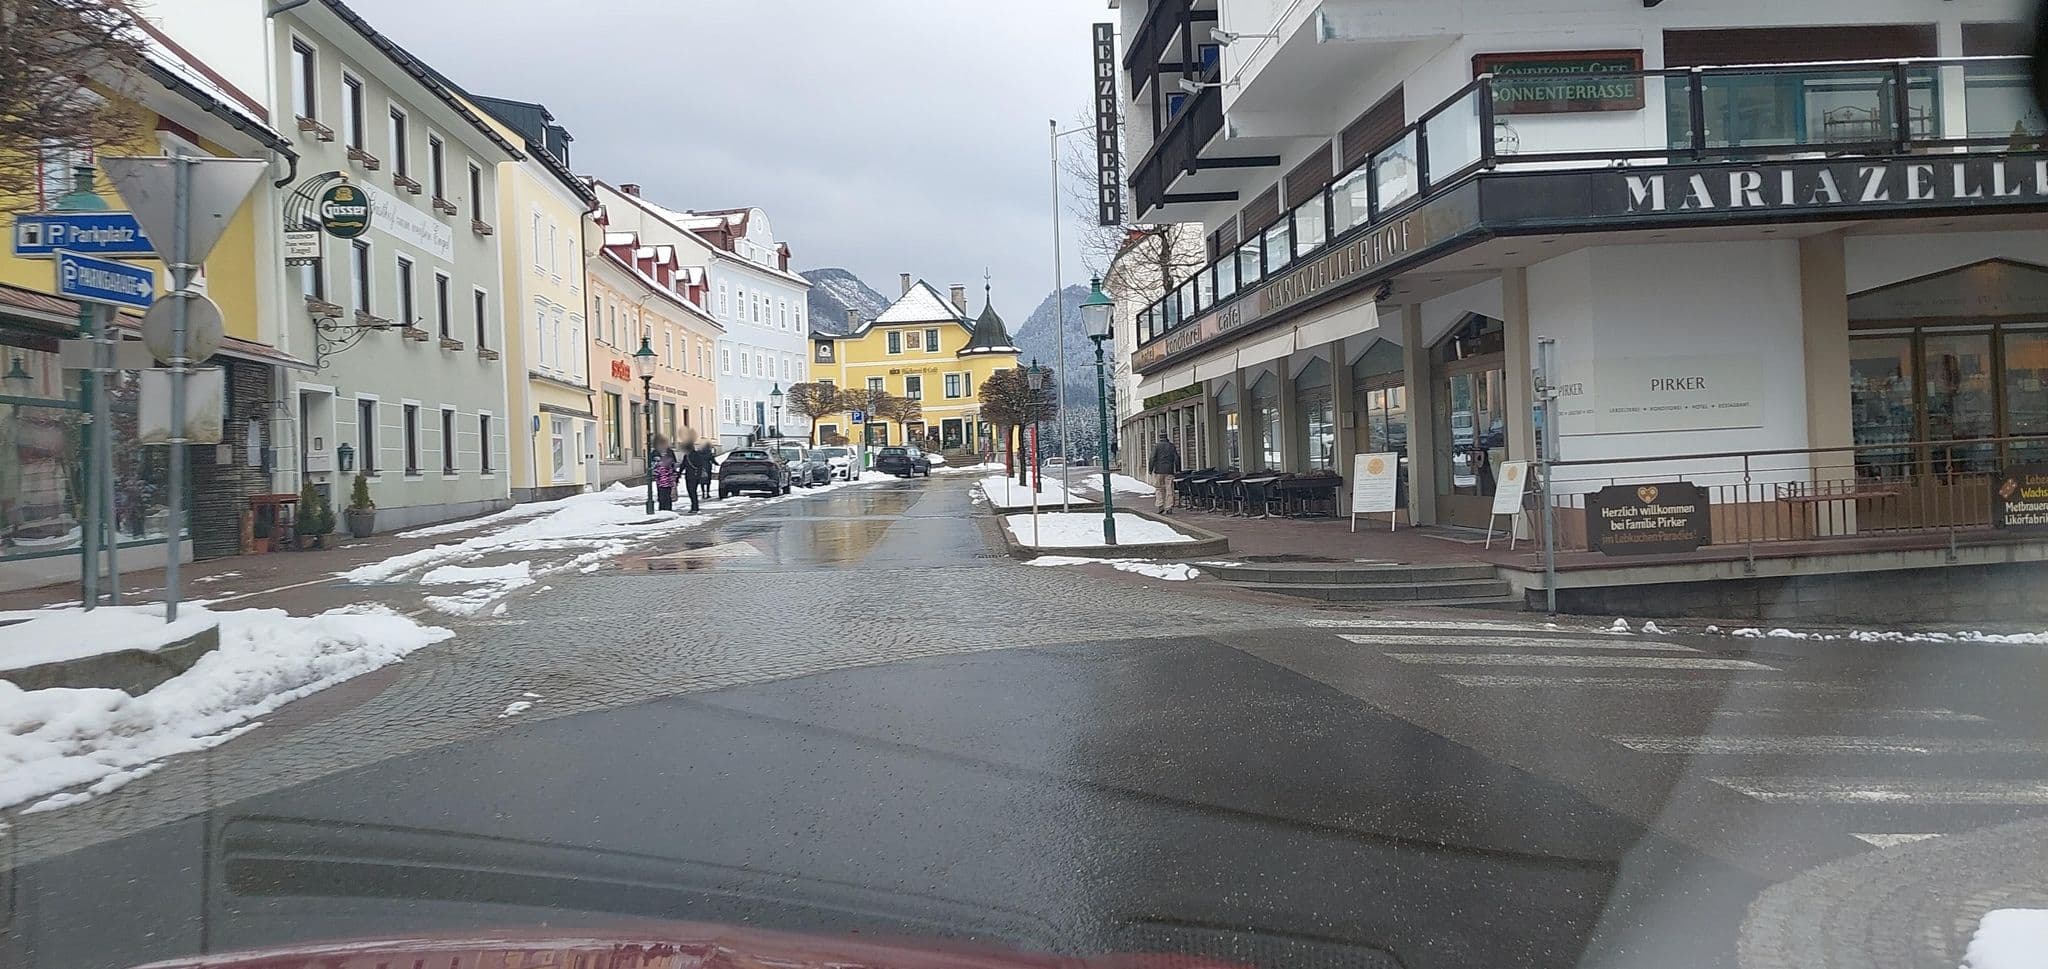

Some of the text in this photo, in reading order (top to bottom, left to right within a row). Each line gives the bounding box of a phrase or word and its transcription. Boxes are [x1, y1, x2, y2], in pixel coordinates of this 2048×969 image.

[1097, 27, 1116, 221] LEBZELTEREI
[321, 201, 367, 218] Gösser
[69, 225, 134, 246] Parkplatz
[1266, 218, 1411, 312] MARIAZELLERHOF
[78, 266, 139, 295] PARKGARAGE
[1558, 383, 1584, 397] PIRKER
[1651, 377, 1706, 392] PIRKER
[1601, 504, 1695, 518] Herzlich willkommen
[1611, 518, 1688, 531] bei Familie Pirker
